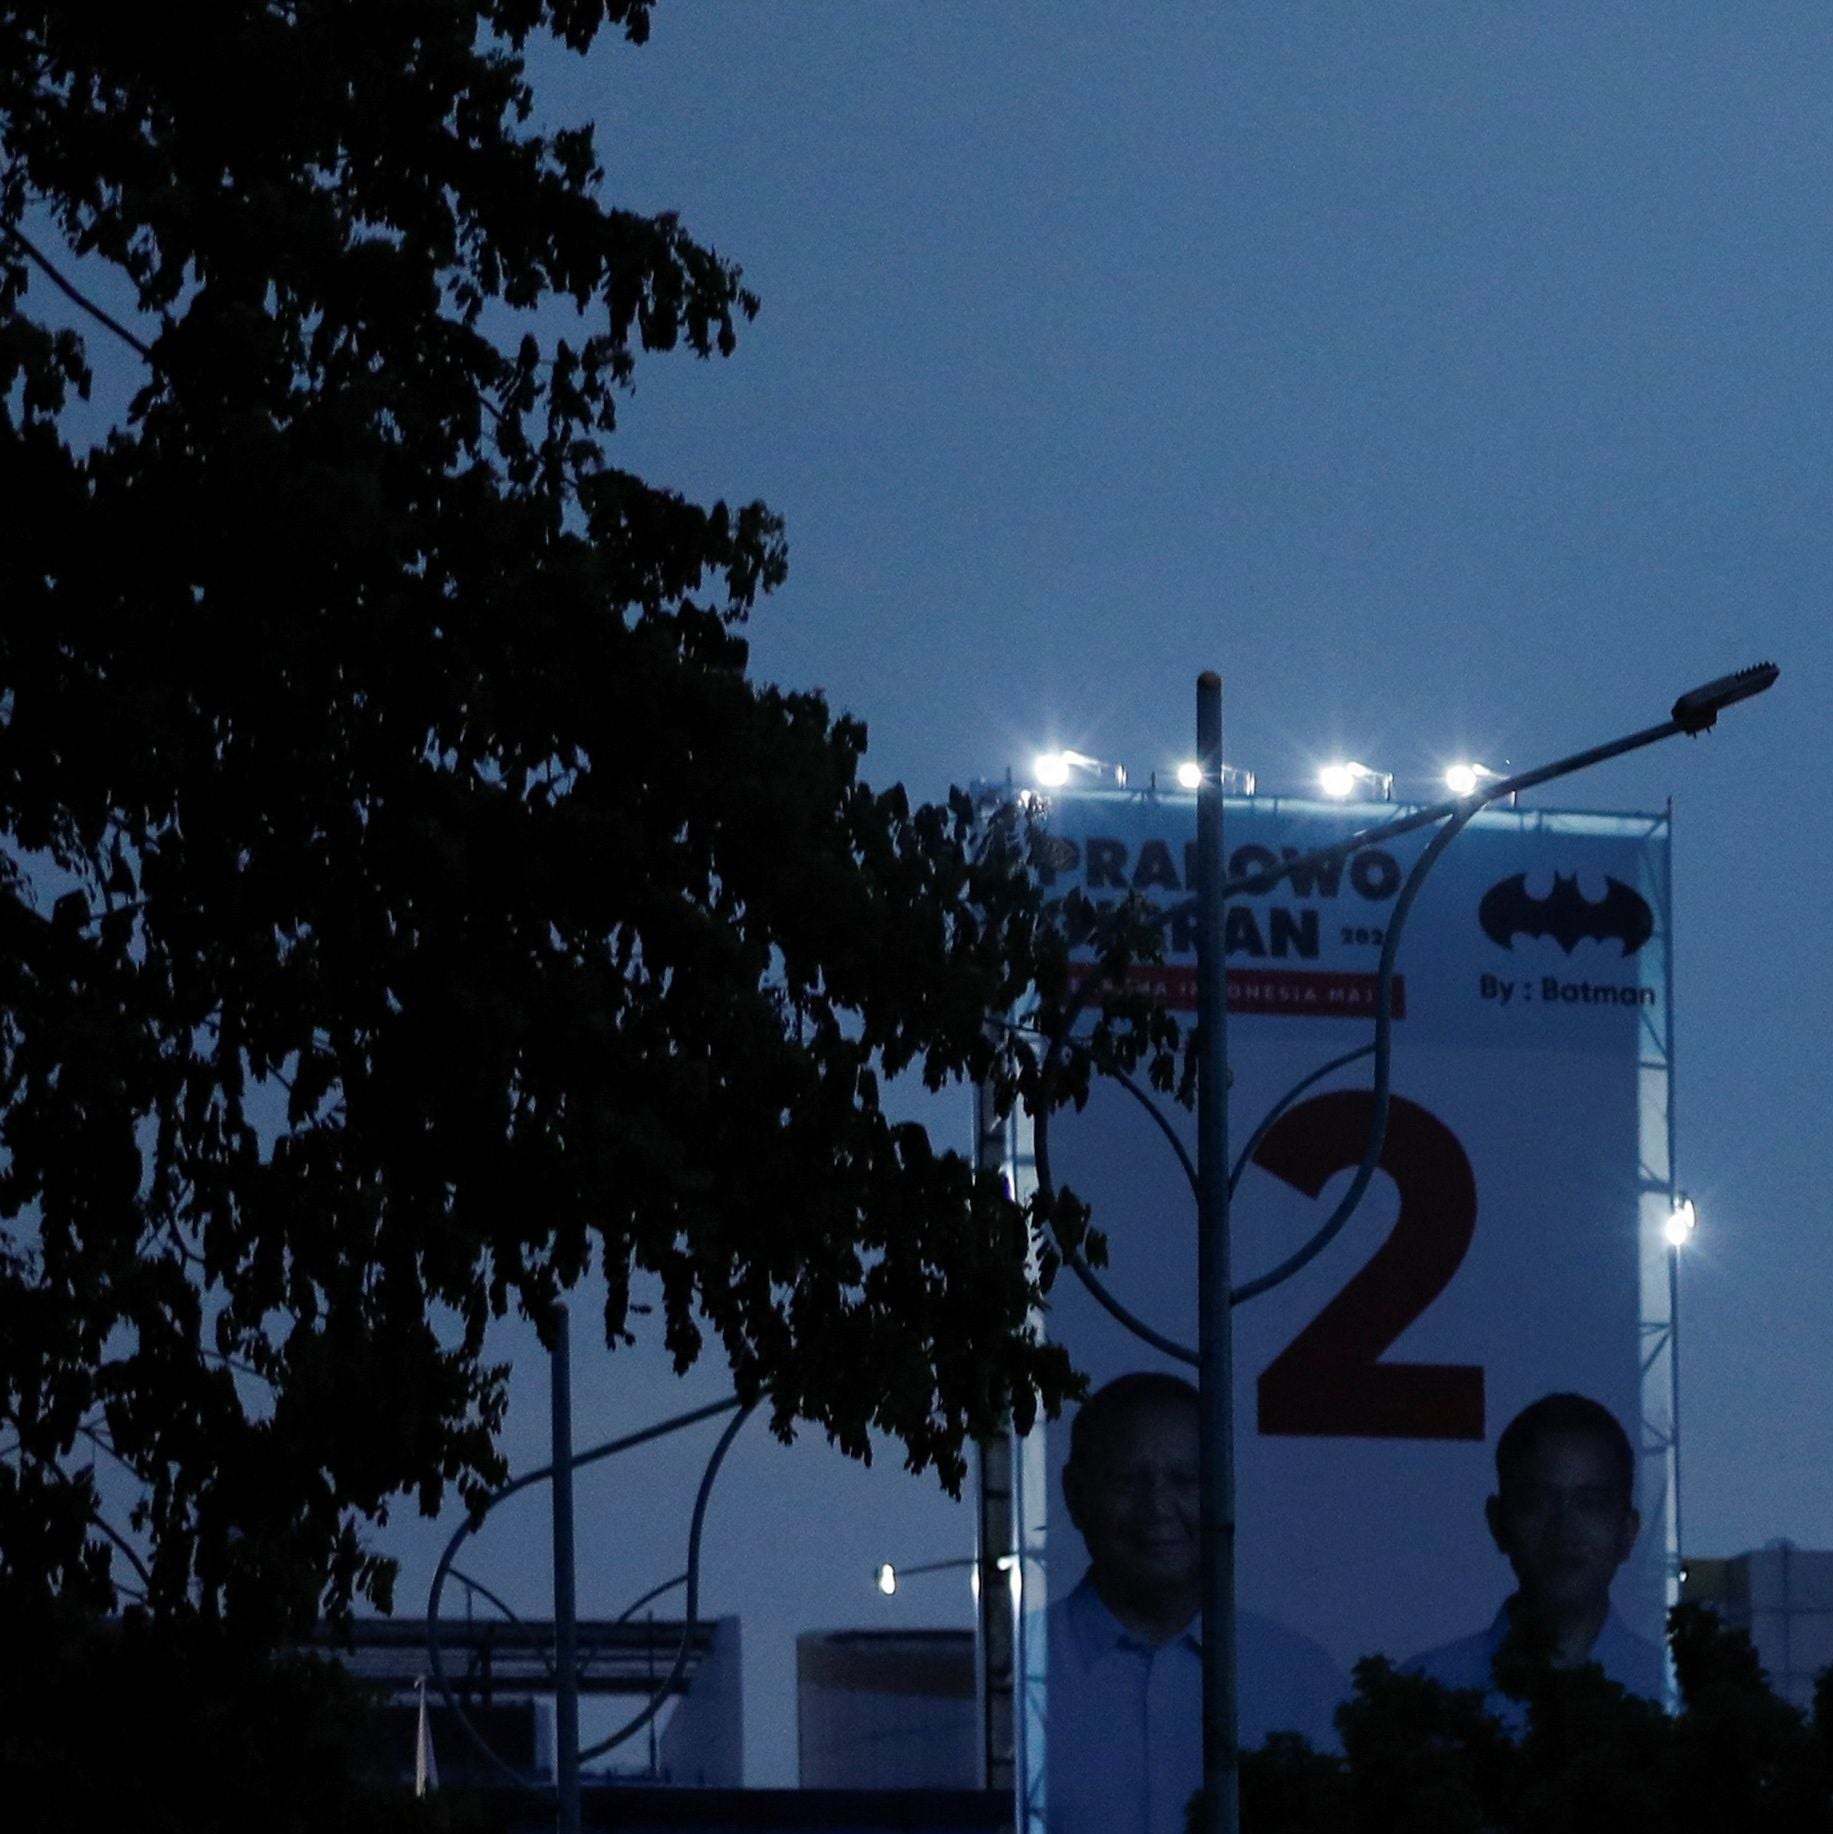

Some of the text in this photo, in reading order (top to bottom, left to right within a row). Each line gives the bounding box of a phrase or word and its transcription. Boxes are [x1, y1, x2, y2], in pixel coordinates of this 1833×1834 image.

[1480, 974, 1514, 1006] By
[1542, 976, 1655, 1005] Batman
[1252, 1090, 1486, 1441] 2
